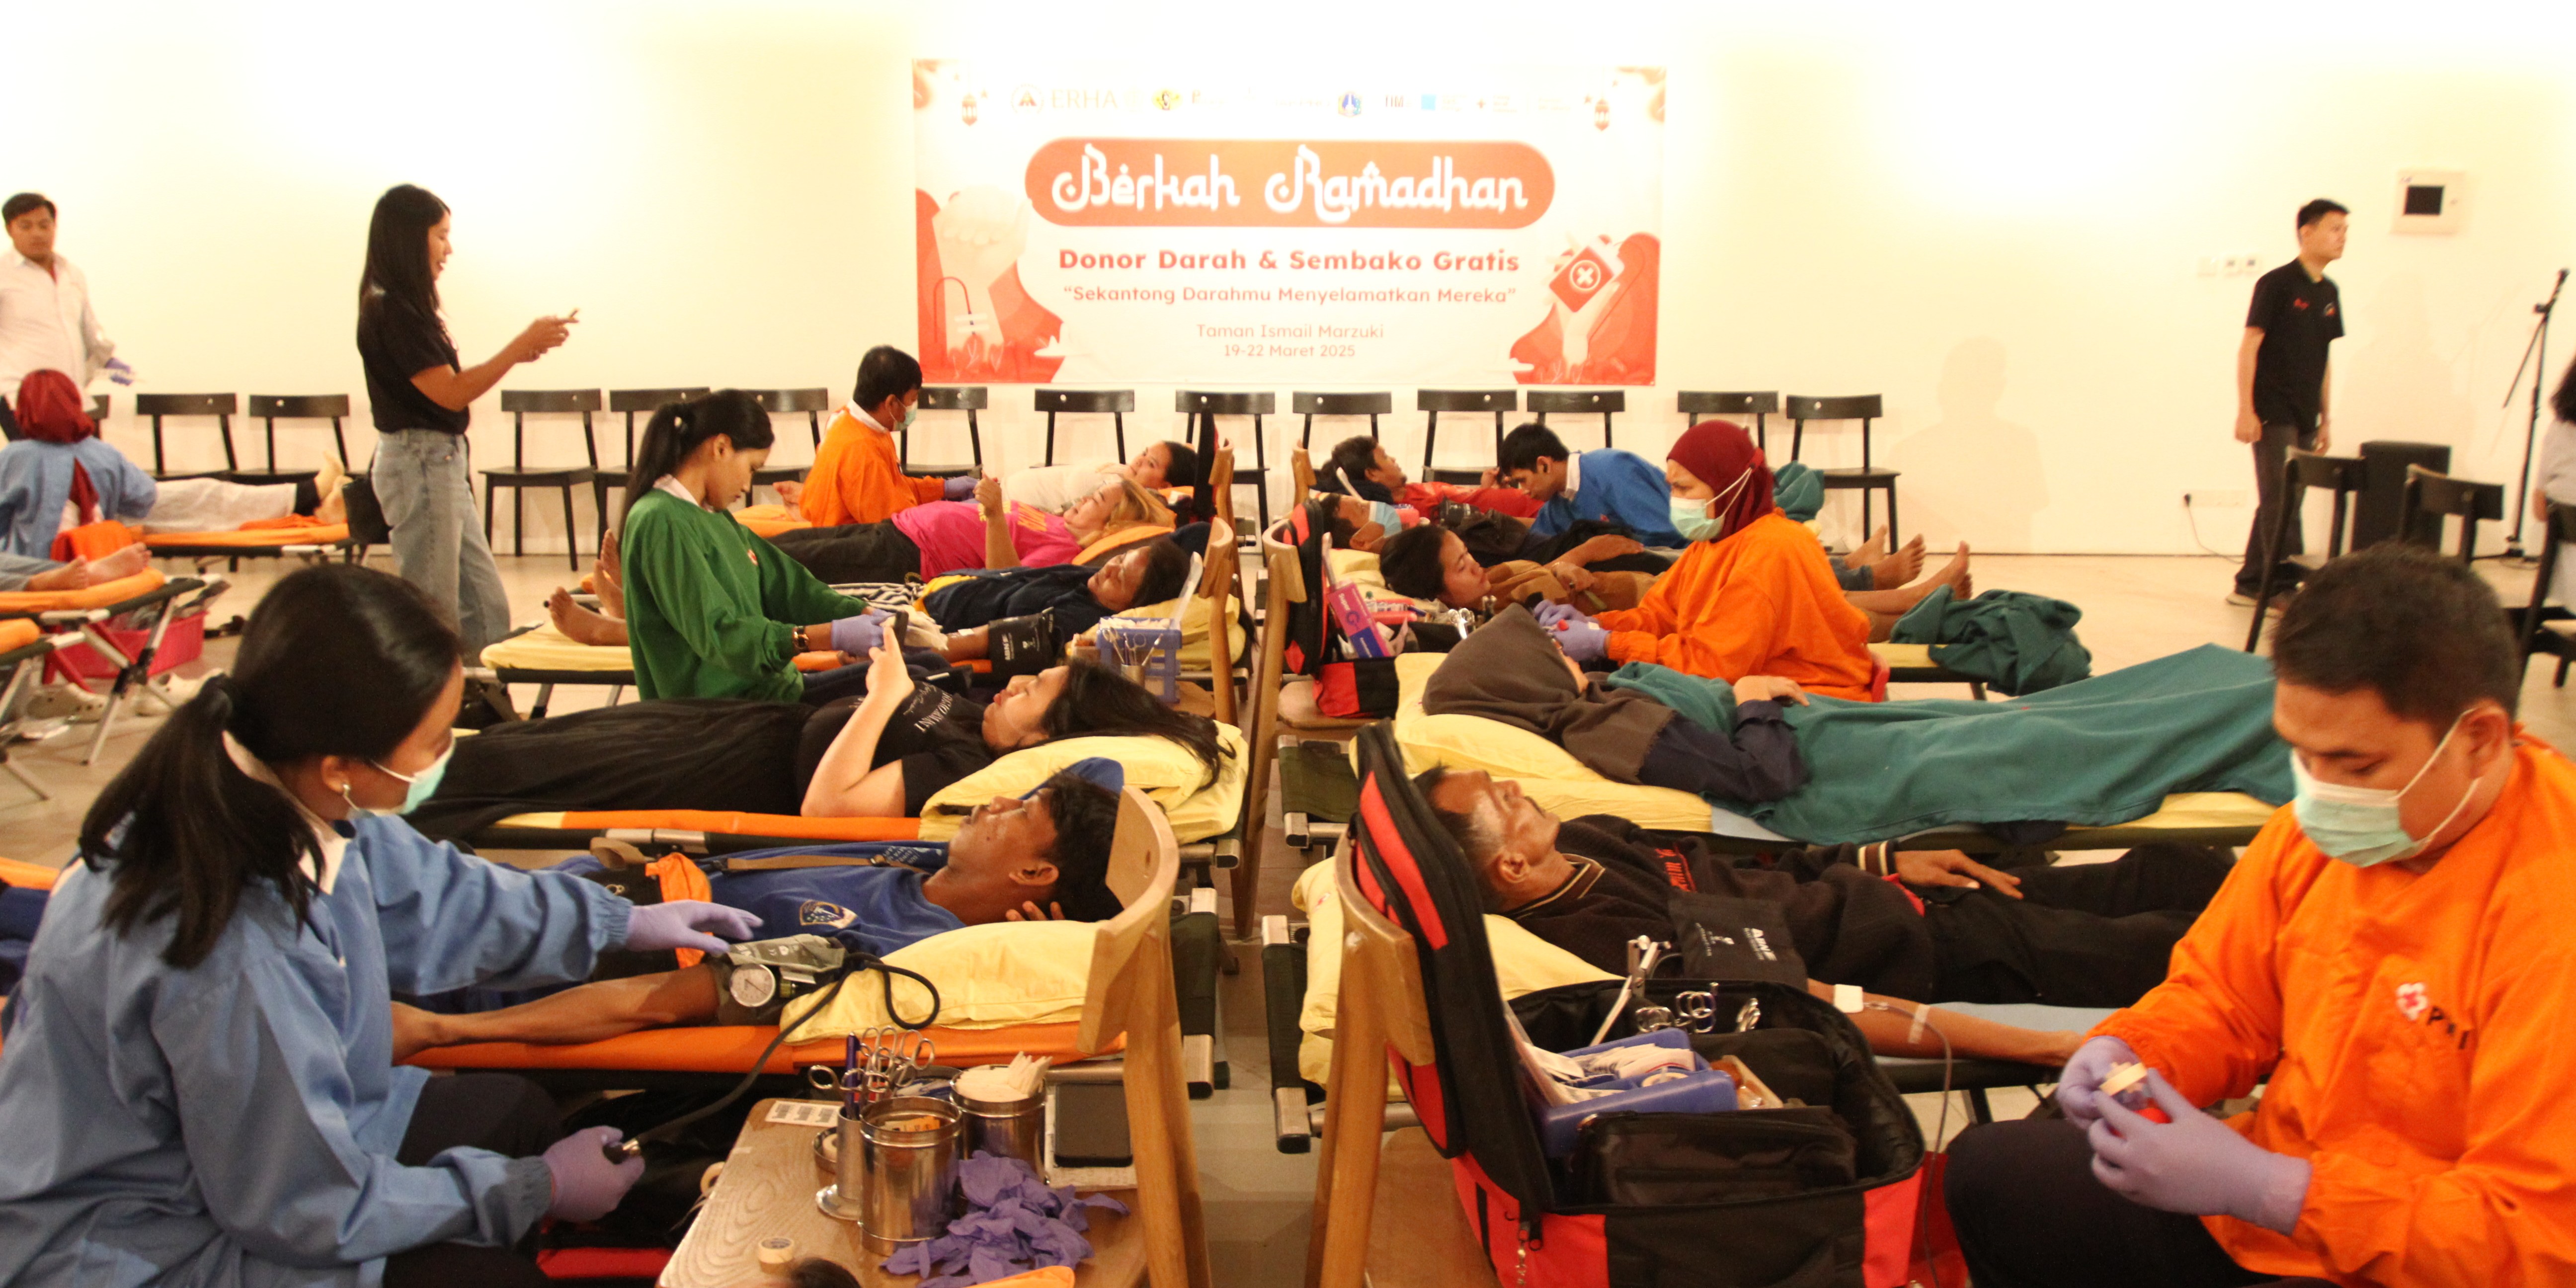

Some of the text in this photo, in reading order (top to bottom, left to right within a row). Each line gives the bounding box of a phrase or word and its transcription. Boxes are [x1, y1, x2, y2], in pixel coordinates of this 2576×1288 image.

[1050, 88, 1118, 109] ERHA
[1051, 143, 1528, 223] Berkah Ramadhan
[1059, 249, 1520, 272] Donor Darah & Sembako Gratis
[1184, 288, 1271, 301] Darahmu
[1279, 288, 1431, 306] Menyelamatkan
[1198, 324, 1384, 338] Taman Ismail Marzuki
[1224, 344, 1356, 357] 19-22 Maret 2025
